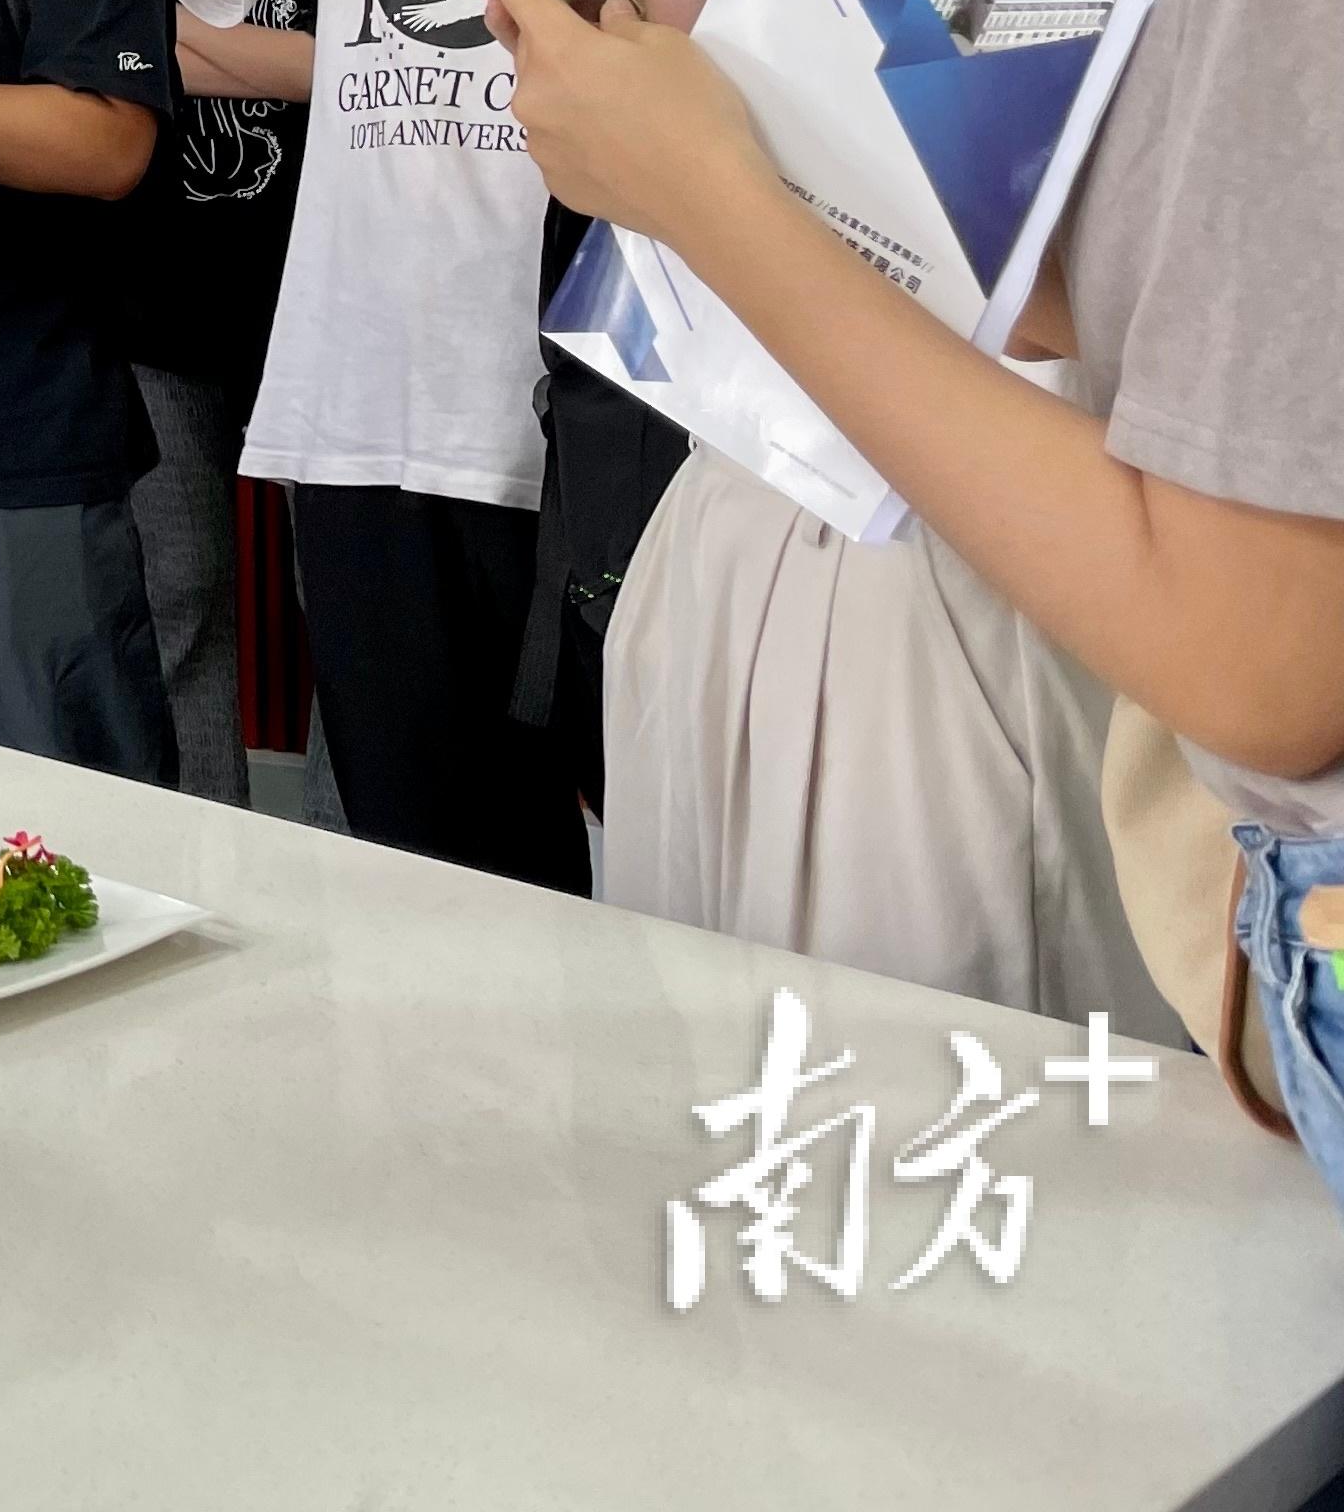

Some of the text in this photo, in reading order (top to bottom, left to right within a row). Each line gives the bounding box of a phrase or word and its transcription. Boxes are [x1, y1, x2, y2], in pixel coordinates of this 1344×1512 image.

[338, 66, 517, 113] GARNET C
[349, 118, 530, 154] 10TH ANNIVERS
